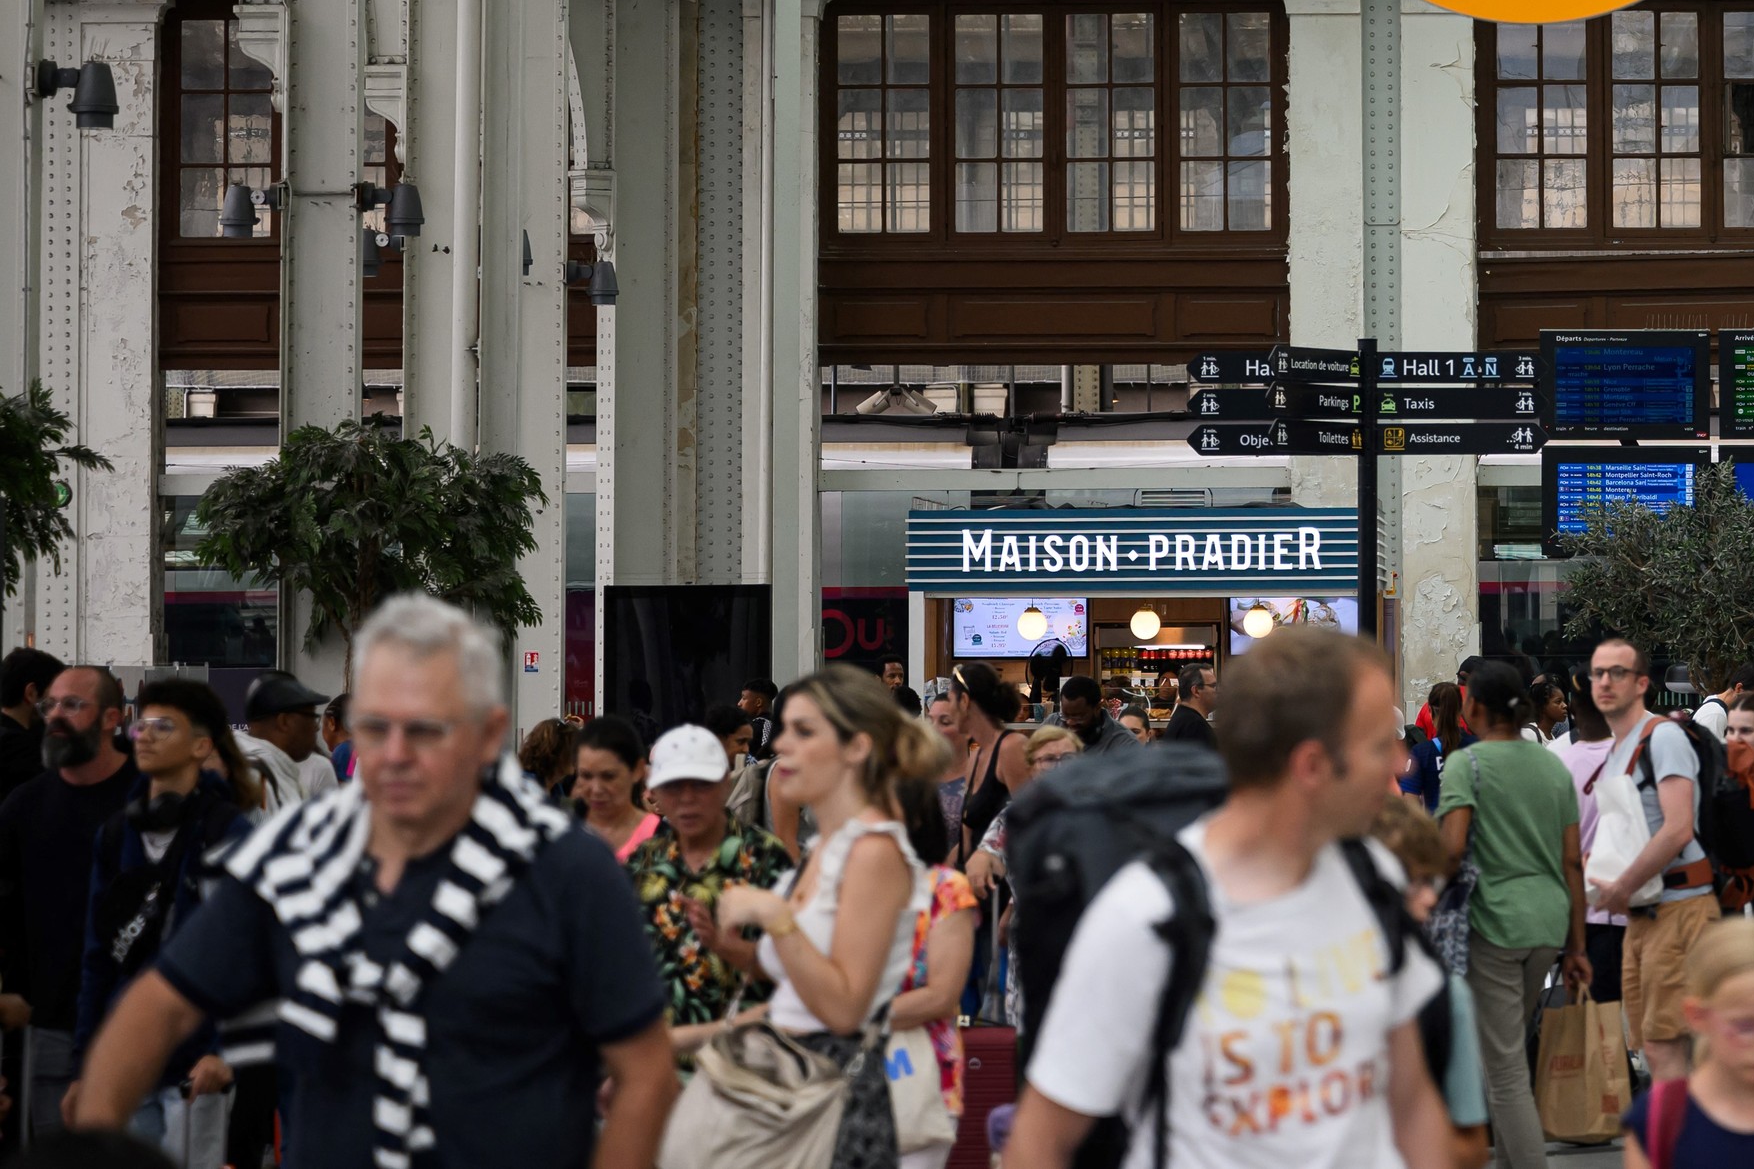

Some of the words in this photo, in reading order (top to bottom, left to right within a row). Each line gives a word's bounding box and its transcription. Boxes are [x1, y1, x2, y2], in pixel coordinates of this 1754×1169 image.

[1291, 358, 1317, 370] Location
[1319, 360, 1326, 370] de
[1328, 362, 1349, 372] voiture
[1403, 359, 1440, 376] Hall
[1446, 359, 1454, 376] 1
[1463, 364, 1474, 375] A
[1485, 364, 1497, 375] N
[1319, 395, 1349, 410] Parkings
[1353, 395, 1360, 410] P
[1404, 398, 1435, 409] Taxis
[1240, 434, 1273, 449] Obje
[1319, 432, 1349, 444] Toilettes
[1409, 433, 1460, 443] Assistance
[961, 528, 1118, 573] MAISON
[1148, 526, 1322, 571] PRADIER
[1272, 1010, 1344, 1077] TO
